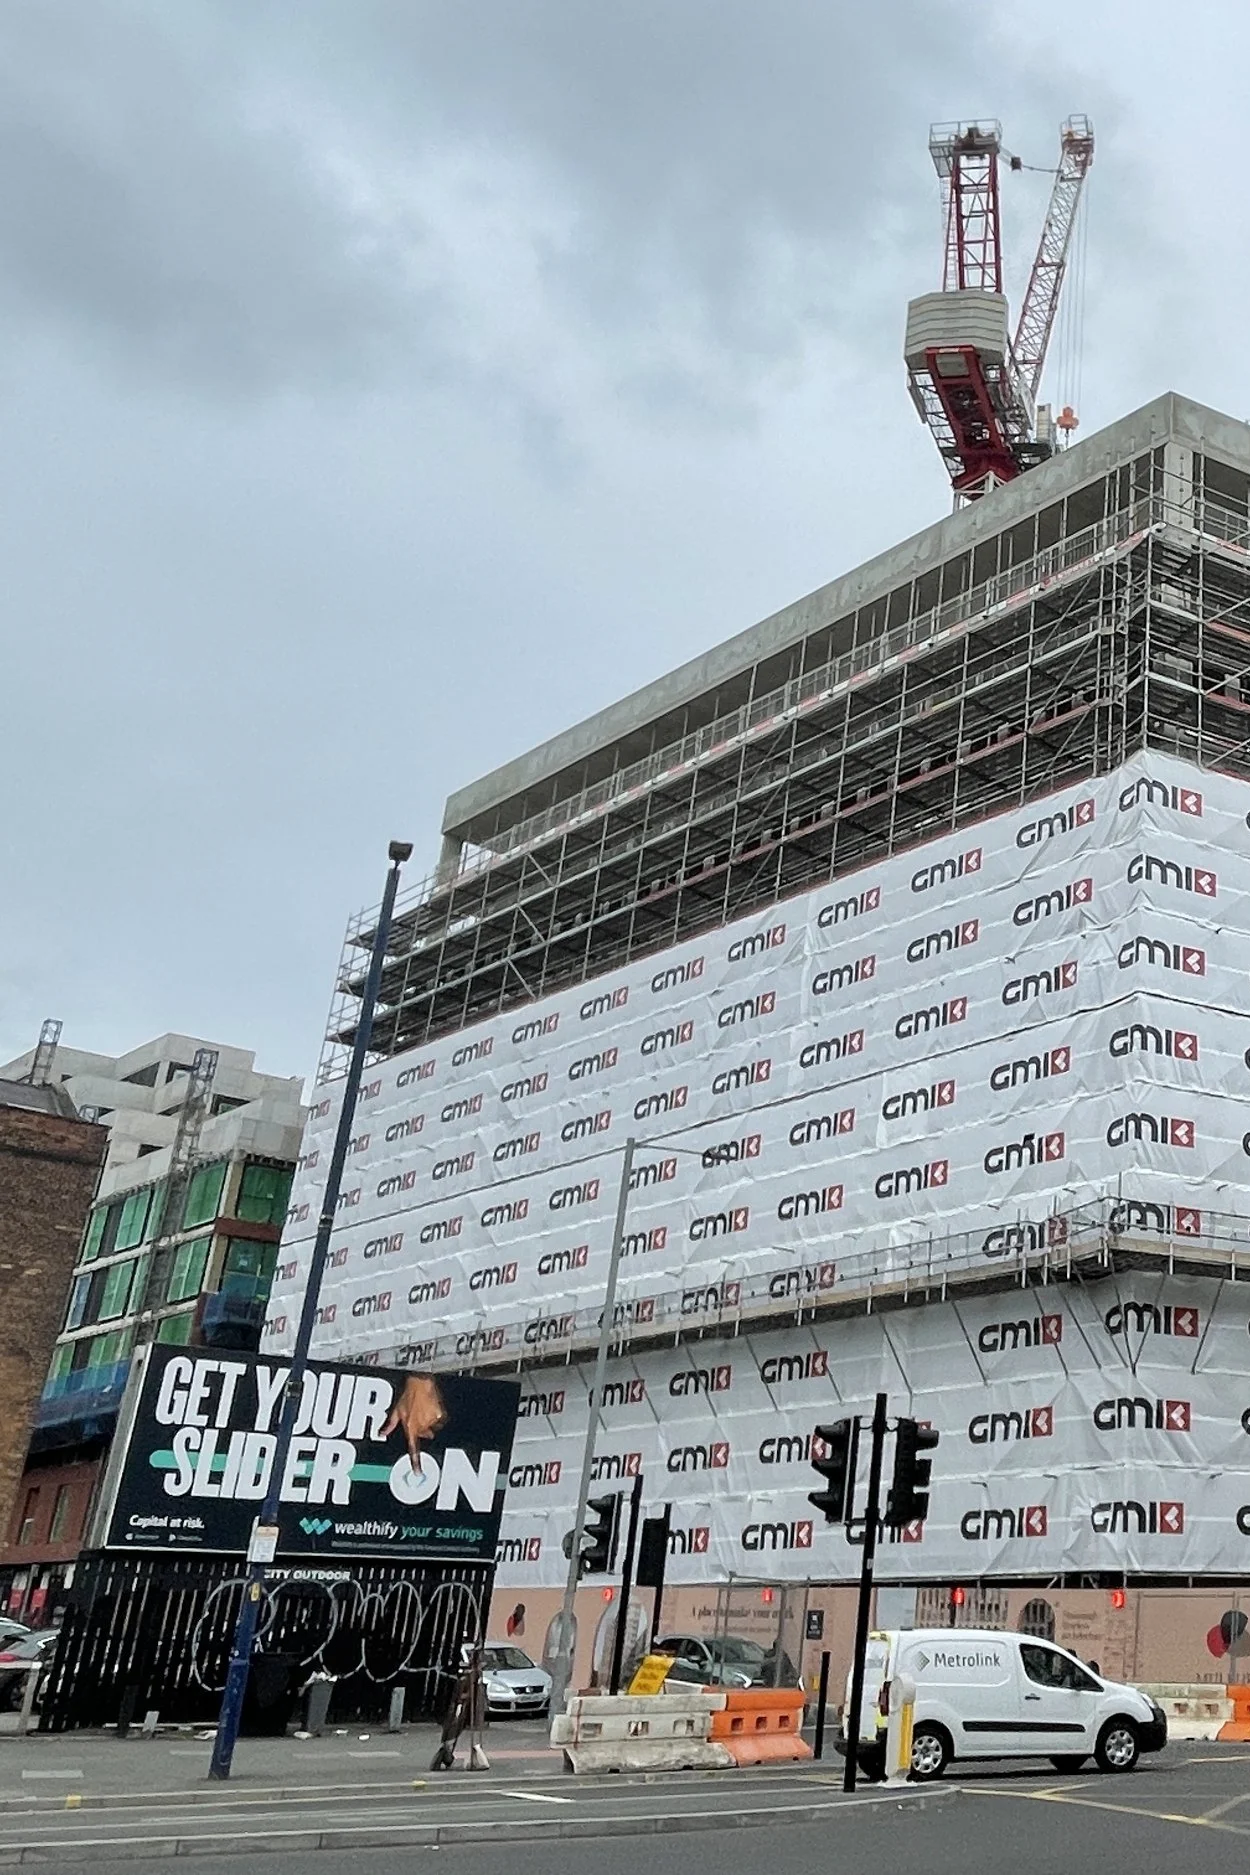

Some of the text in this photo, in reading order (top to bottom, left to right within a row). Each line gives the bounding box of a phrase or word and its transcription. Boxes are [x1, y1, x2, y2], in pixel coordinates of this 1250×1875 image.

[155, 1356, 394, 1442] GET YOUR
[163, 1426, 502, 1513] SLIDER ON
[129, 1514, 168, 1530] Capital
[170, 1517, 182, 1528] at
[334, 1520, 483, 1542] wealthify your savings
[294, 1569, 350, 1580] OUTDOOR
[934, 1651, 1000, 1668] Metrolink
